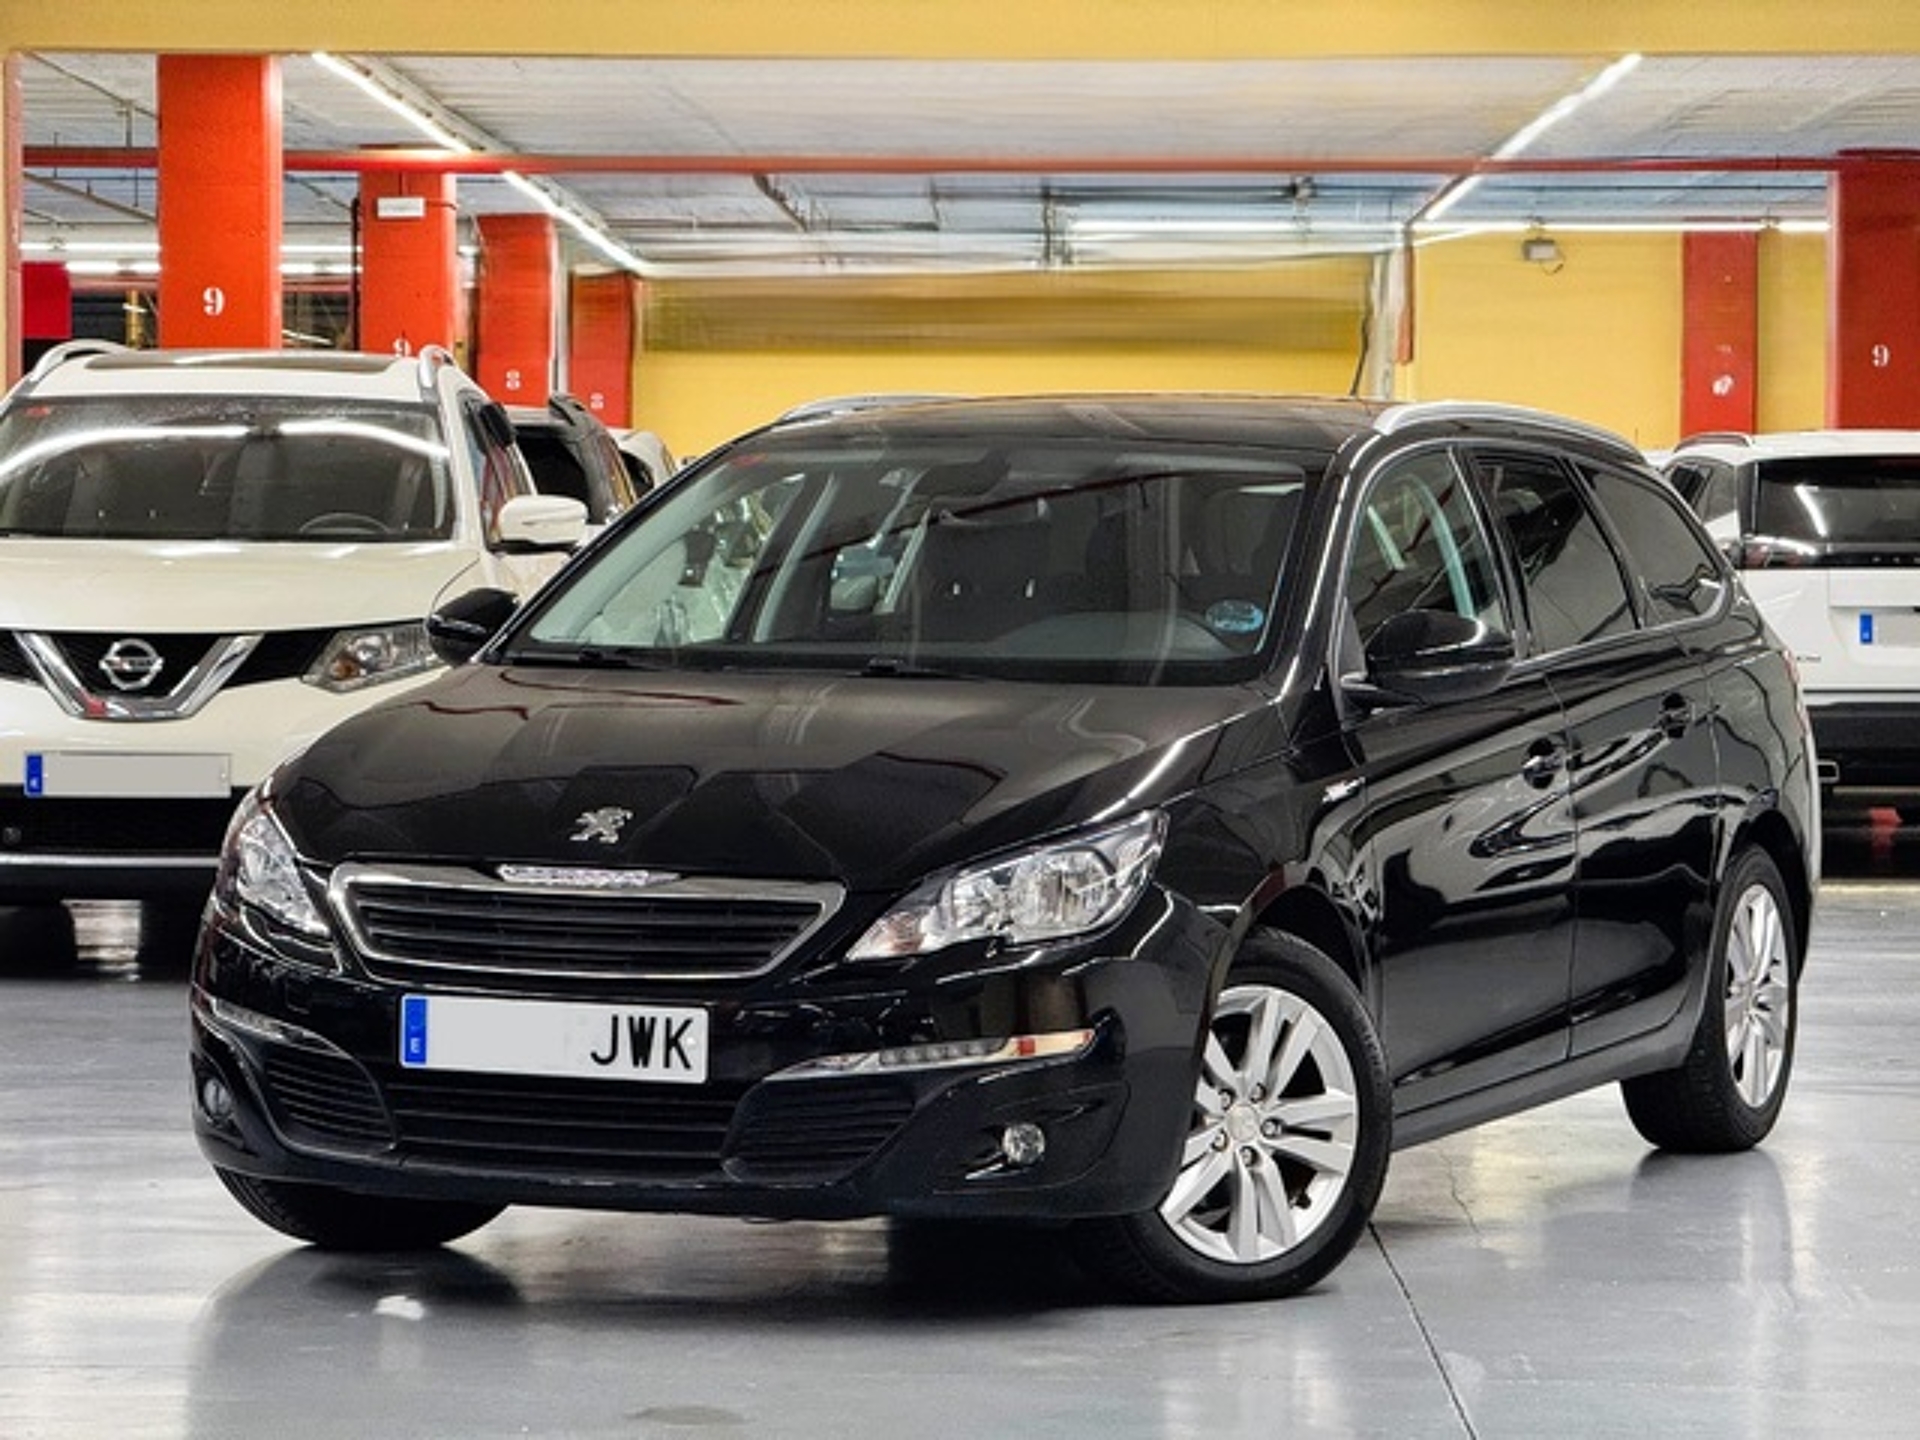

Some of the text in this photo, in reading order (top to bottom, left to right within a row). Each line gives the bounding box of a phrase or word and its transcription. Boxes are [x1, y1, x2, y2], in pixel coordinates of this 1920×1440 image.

[203, 287, 225, 316] 9
[1871, 344, 1890, 367] 9
[590, 1014, 694, 1070] JWK
